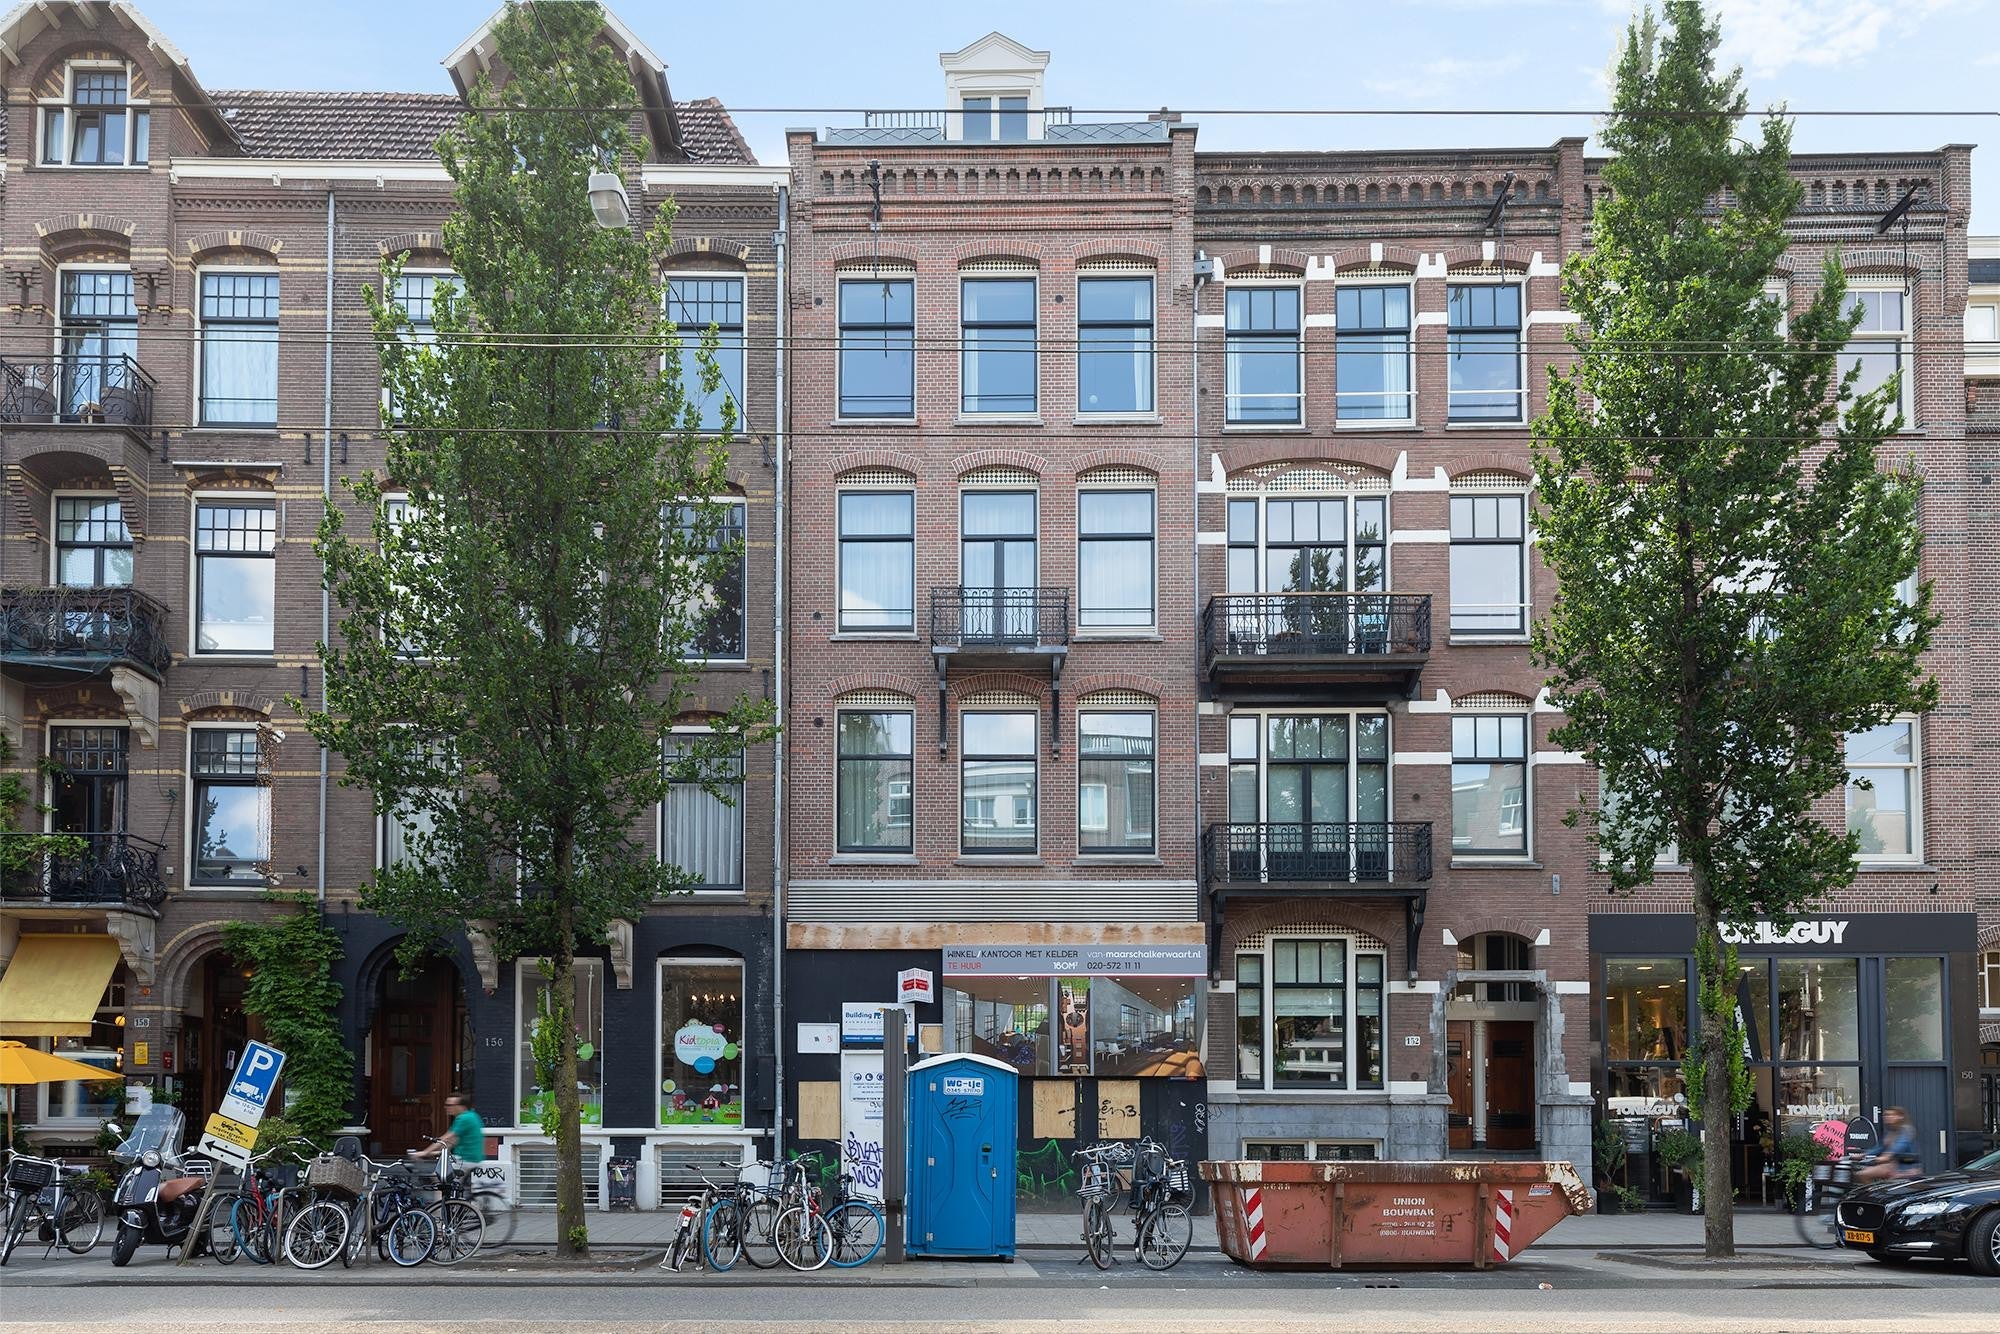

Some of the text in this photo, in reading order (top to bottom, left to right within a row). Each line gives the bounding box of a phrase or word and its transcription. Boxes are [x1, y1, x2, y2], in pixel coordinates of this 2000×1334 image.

[947, 950, 1022, 958] WINKEL/KANTOOR
[1025, 950, 1042, 958] MET
[1045, 950, 1079, 958] KELDER
[1087, 961, 1141, 970] 020-572 11 11
[845, 1011, 872, 1020] Building
[135, 1018, 148, 1027] 158
[485, 1037, 503, 1047] 156
[679, 1034, 720, 1048] Kidtopia
[1407, 1037, 1420, 1045] 152
[246, 1048, 274, 1077] P
[1961, 1070, 1974, 1080] 150
[1616, 1104, 1680, 1116] TONI&GUY
[1787, 1104, 1851, 1116] TONI&GUY
[1393, 1197, 1426, 1206] UNION
[1383, 1208, 1435, 1217] BOUWBAK
